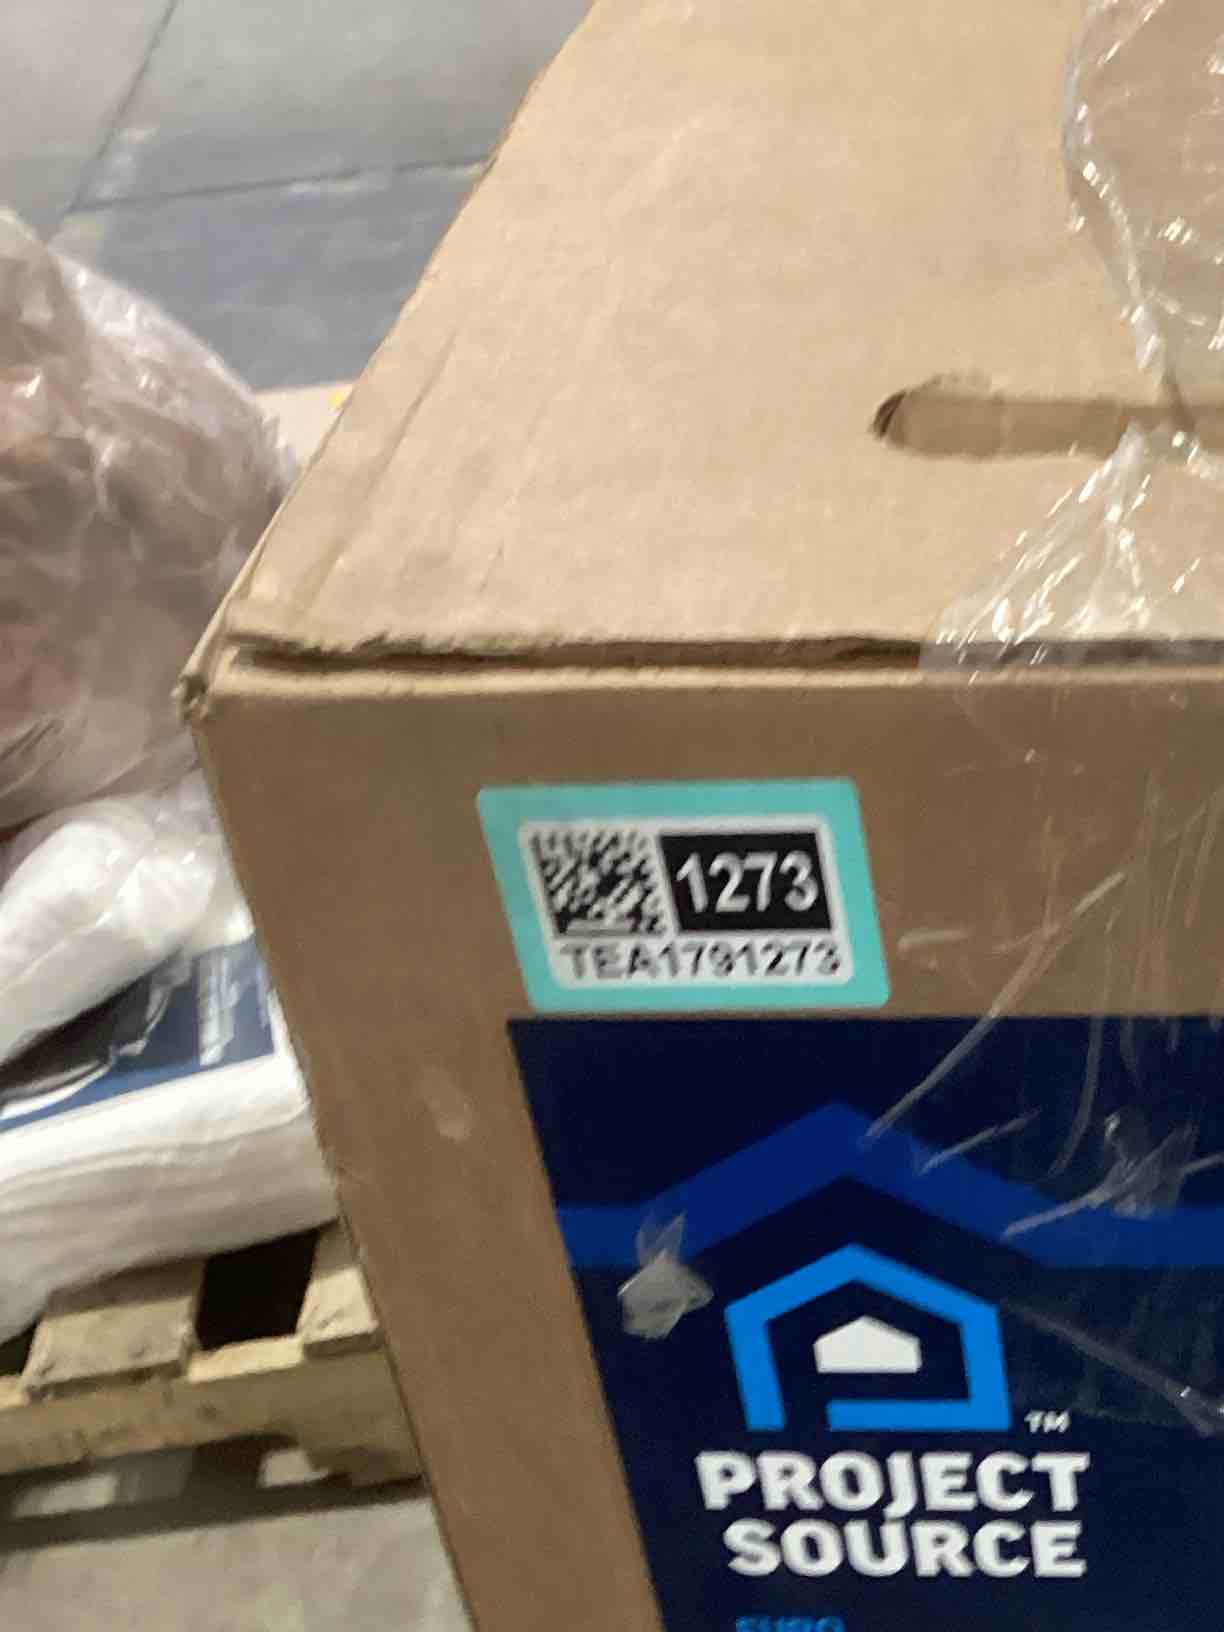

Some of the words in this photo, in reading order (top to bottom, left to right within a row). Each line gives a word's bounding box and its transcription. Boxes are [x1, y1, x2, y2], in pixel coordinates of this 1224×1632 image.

[676, 850, 819, 913] 1273
[695, 1449, 1091, 1518] PROJECT
[723, 1516, 1087, 1578] SOURCE
